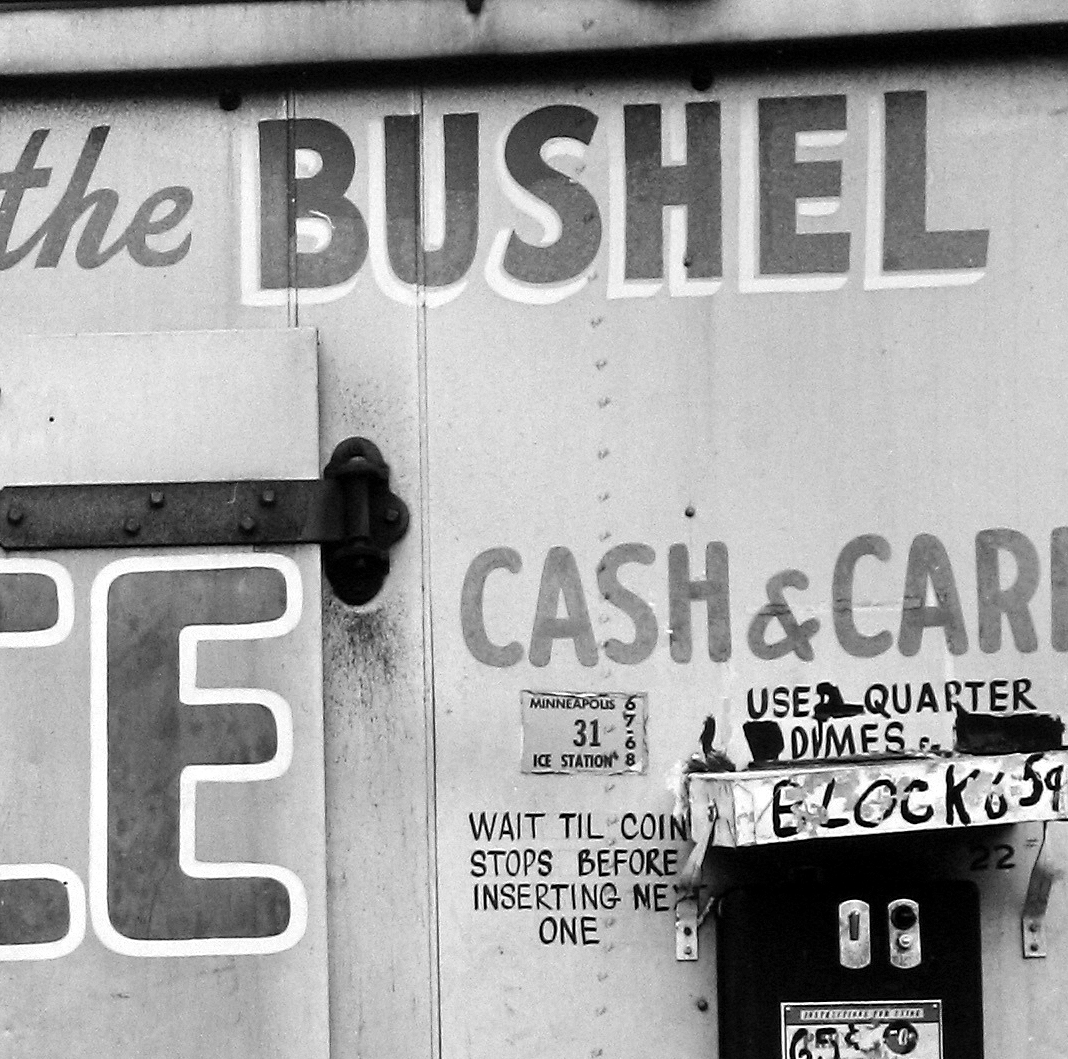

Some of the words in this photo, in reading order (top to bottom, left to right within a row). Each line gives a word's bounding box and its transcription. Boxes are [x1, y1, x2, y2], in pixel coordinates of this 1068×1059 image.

[240, 91, 989, 307] BUSHEL
[460, 541, 731, 667] CASH
[747, 569, 820, 661] &
[530, 698, 615, 710] MINNEAPOLIS
[864, 678, 1037, 718] QUARTER
[573, 719, 601, 747] 31
[533, 754, 552, 768] ICE
[561, 753, 613, 768] STATION
[469, 811, 546, 841] WAIT
[559, 812, 604, 839] TIL
[620, 812, 688, 841] COIN
[470, 849, 553, 877] STOPS
[578, 848, 677, 877] BEFORE
[969, 843, 1016, 871] 22
[473, 882, 621, 911] INSERTING
[539, 916, 600, 945] ONE
